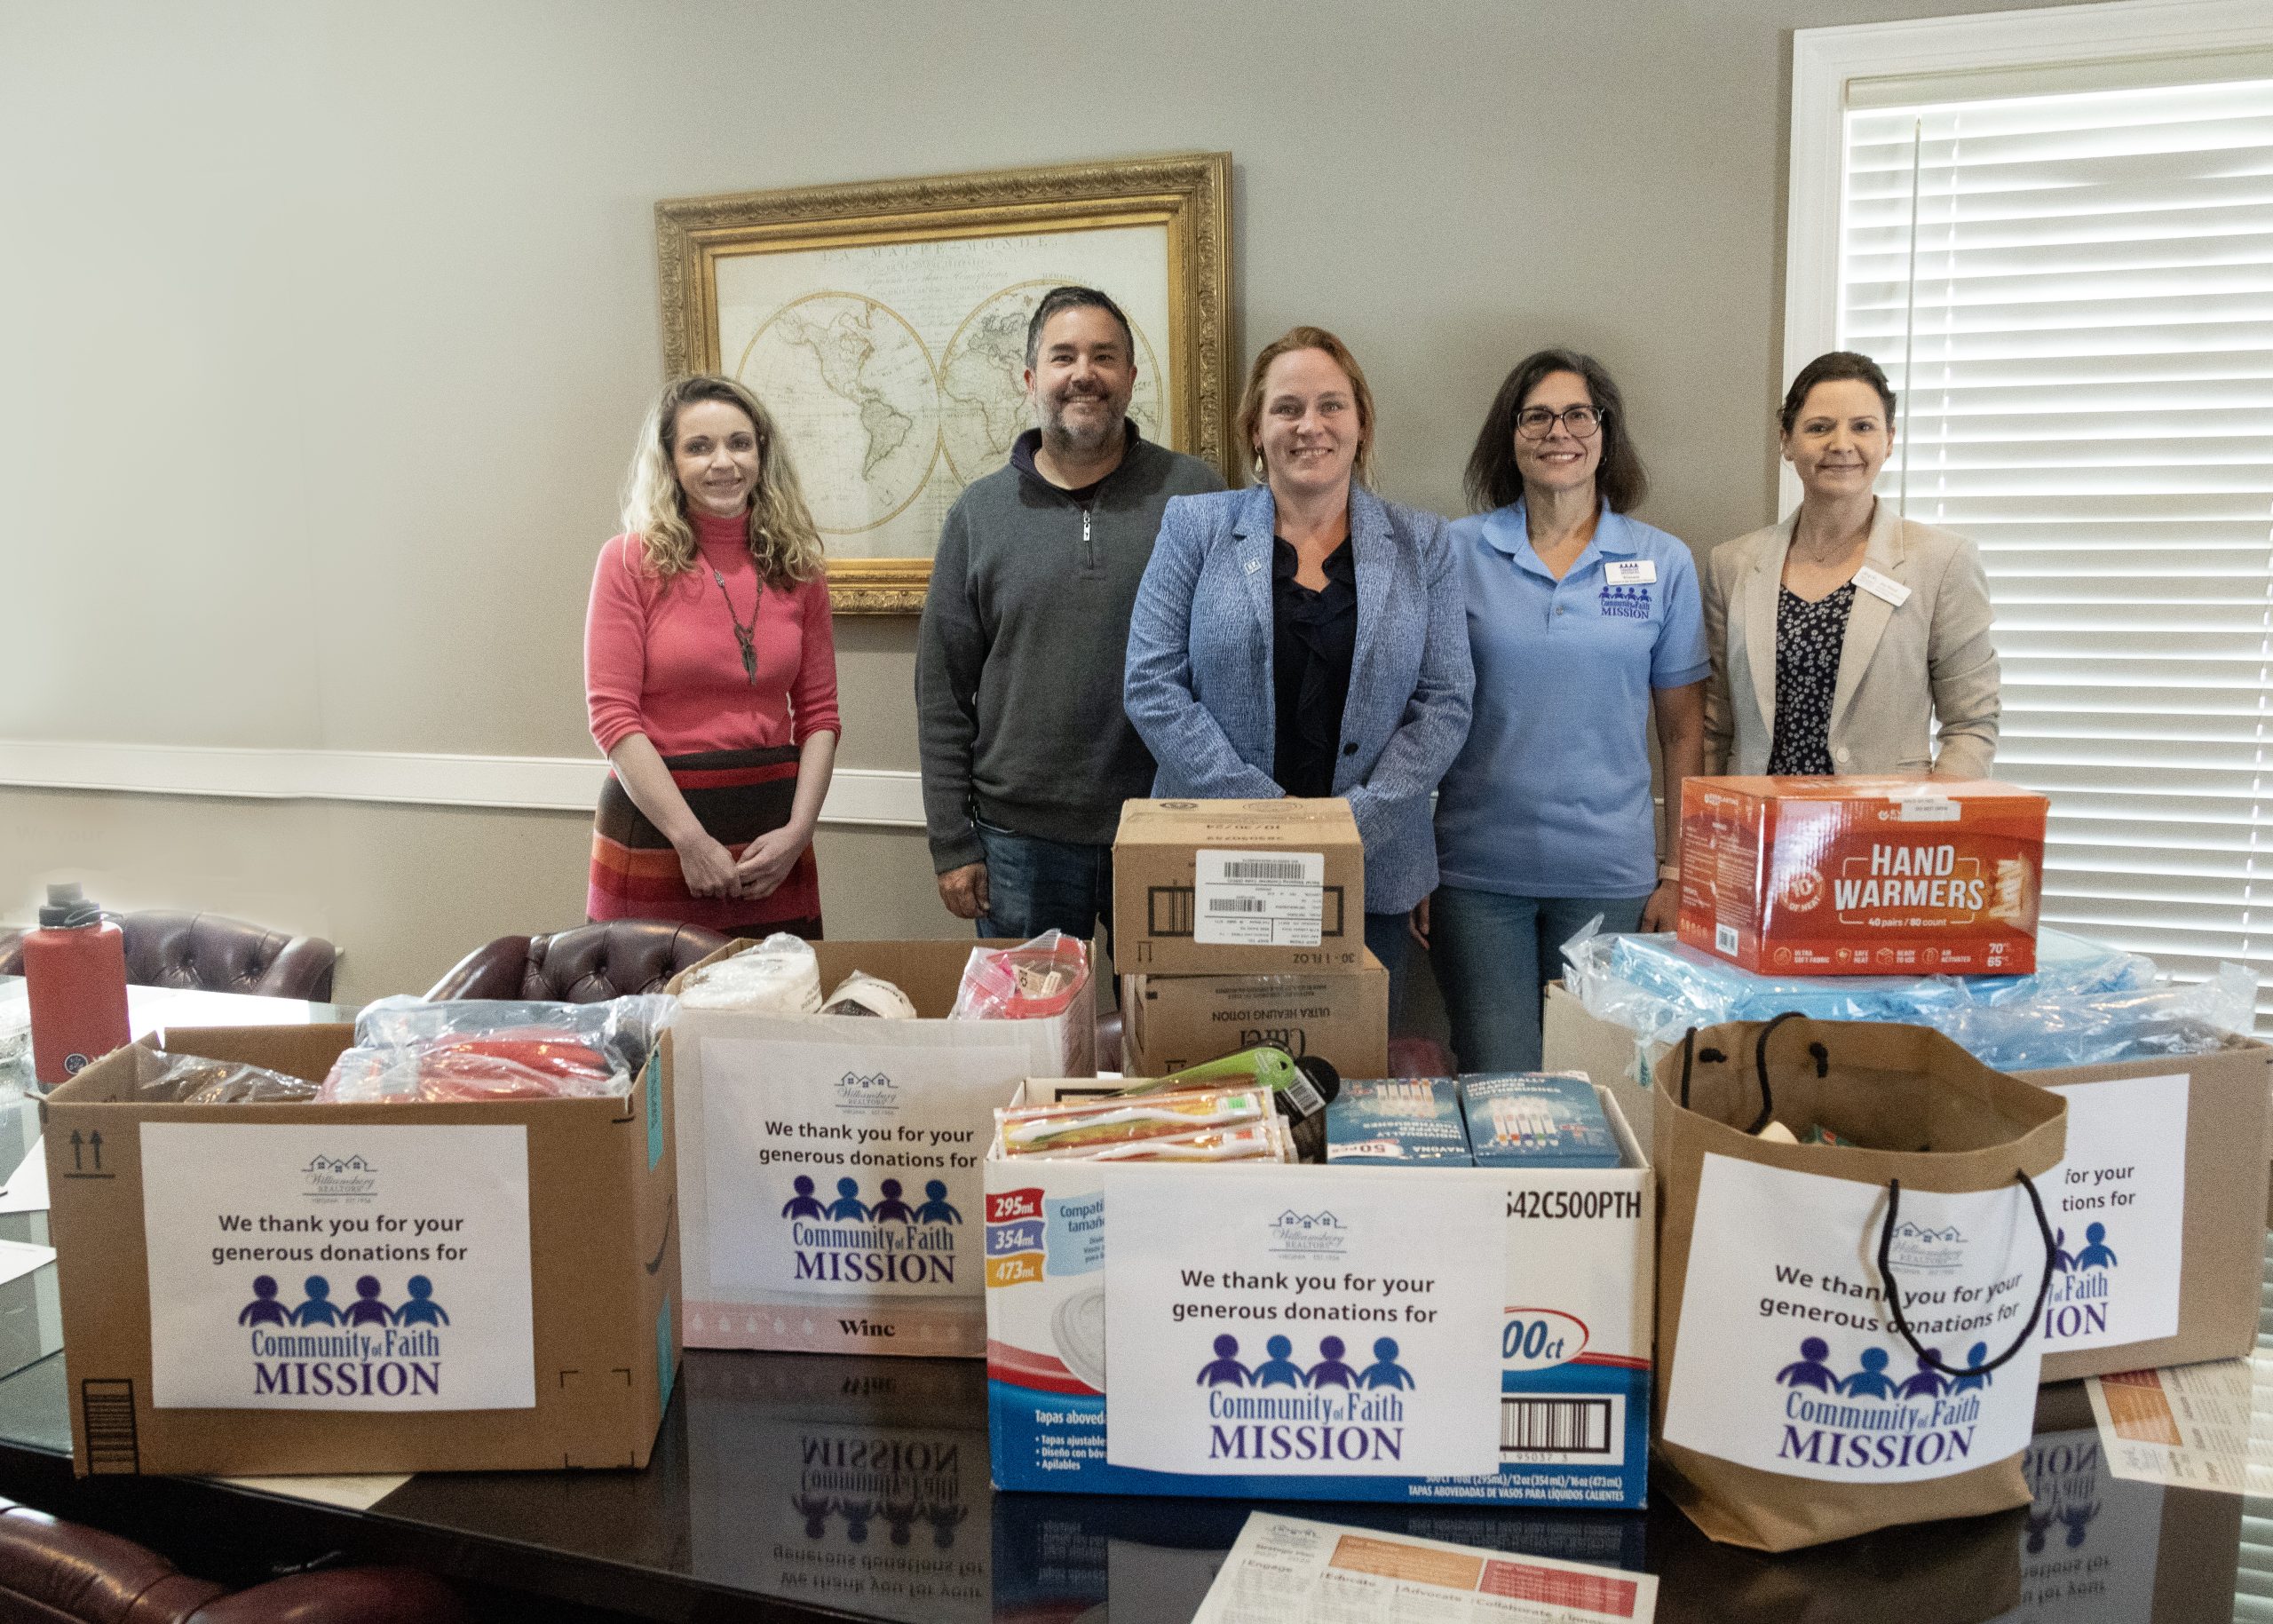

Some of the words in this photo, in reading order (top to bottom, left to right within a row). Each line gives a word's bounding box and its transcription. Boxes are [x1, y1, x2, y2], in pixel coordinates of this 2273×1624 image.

[1601, 606, 1649, 620] MISSION
[1871, 844, 1955, 876] HAND
[1833, 879, 1985, 910] WARMERS
[1922, 918, 1947, 927] count
[1212, 1010, 1251, 1022] LOTION
[1254, 1009, 1297, 1020] HEALING
[1299, 1007, 1330, 1019] ULTRA
[764, 1121, 794, 1137] We
[798, 1121, 852, 1140] thank
[858, 1129, 892, 1145] you
[897, 1126, 924, 1142] for
[930, 1129, 975, 1146] your
[759, 1149, 844, 1165] generous
[850, 1150, 945, 1168] donations
[949, 1153, 978, 1168] for
[2064, 1168, 2089, 1184] for
[2094, 1165, 2135, 1185] your
[2062, 1194, 2105, 1211] tions
[2111, 1191, 2136, 1207] for
[218, 1215, 252, 1232] We
[258, 1215, 323, 1233] thank
[329, 1218, 369, 1237] you
[376, 1215, 408, 1232] for
[413, 1217, 463, 1237] your
[793, 1222, 894, 1252] Community
[907, 1225, 954, 1251] Faith
[211, 1246, 313, 1265] generous
[320, 1243, 430, 1261] donations
[436, 1243, 468, 1261] for
[794, 1250, 956, 1284] MISSION
[1180, 1270, 1215, 1288] We
[1223, 1271, 1288, 1289] thank
[1295, 1275, 1335, 1295] you
[1343, 1273, 1376, 1292] for
[1382, 1277, 1435, 1296] your
[1775, 1264, 1813, 1287] We
[1903, 1289, 1945, 1309] you
[1952, 1286, 1983, 1303] for
[1985, 1272, 2024, 1304] your
[2065, 1271, 2109, 1301] Faith
[1172, 1303, 1278, 1321] generous
[1284, 1302, 1398, 1322] donations
[1405, 1305, 1437, 1323] for
[1760, 1297, 1880, 1333] generous
[1998, 1303, 2020, 1322] for
[2044, 1302, 2109, 1339] ION
[837, 1319, 896, 1337] Winc
[251, 1329, 370, 1362] Community
[385, 1329, 440, 1358] Faith
[252, 1361, 441, 1397] MISSION
[1035, 1409, 1064, 1426] Tapas
[1065, 1409, 1105, 1425] aboved
[1209, 1390, 1333, 1424] Community
[1347, 1392, 1404, 1422] Faith
[1786, 1390, 1920, 1435] Community
[1931, 1394, 1980, 1428] Faith
[1041, 1435, 1065, 1446] Tapas
[1208, 1424, 1405, 1462] MISSION
[1777, 1423, 1977, 1470] MISSION
[1041, 1458, 1081, 1471] Apilables
[1072, 1449, 1087, 1458] con
[1408, 1485, 1432, 1496] TAPAS
[1433, 1485, 1485, 1498] ABOVEDADAS
[1486, 1486, 1497, 1498] DE
[1499, 1486, 1524, 1499] VASOS
[1525, 1487, 1546, 1499] PARA
[1585, 1489, 1624, 1501] CALIENTES
